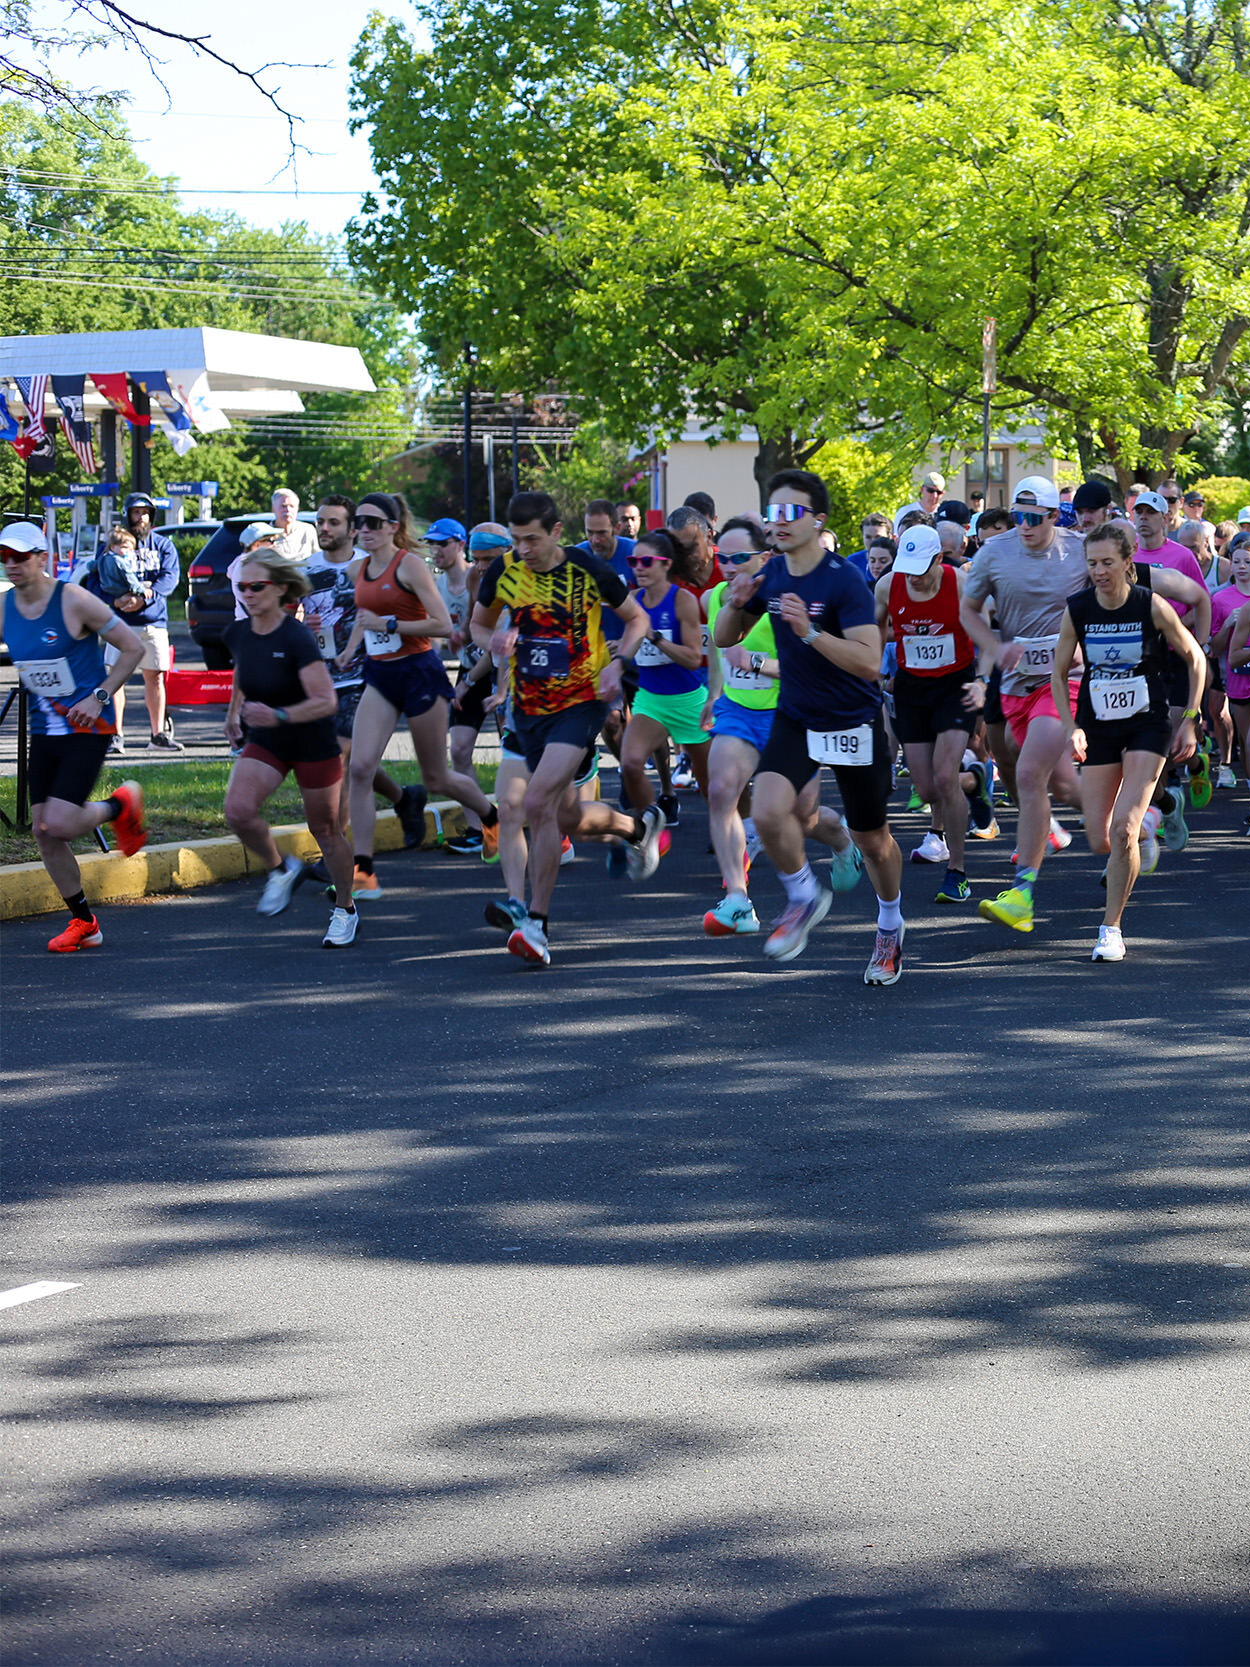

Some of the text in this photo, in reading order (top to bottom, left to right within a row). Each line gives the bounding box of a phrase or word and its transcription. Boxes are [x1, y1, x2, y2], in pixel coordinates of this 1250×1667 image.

[70, 484, 94, 493] Liberty
[166, 483, 192, 492] Liberty
[1088, 624, 1118, 633] STAND
[1119, 622, 1142, 631] WITH
[530, 649, 549, 667] 26
[915, 644, 944, 661] 1337
[1102, 690, 1136, 709] 1287
[822, 735, 859, 753] 1199
